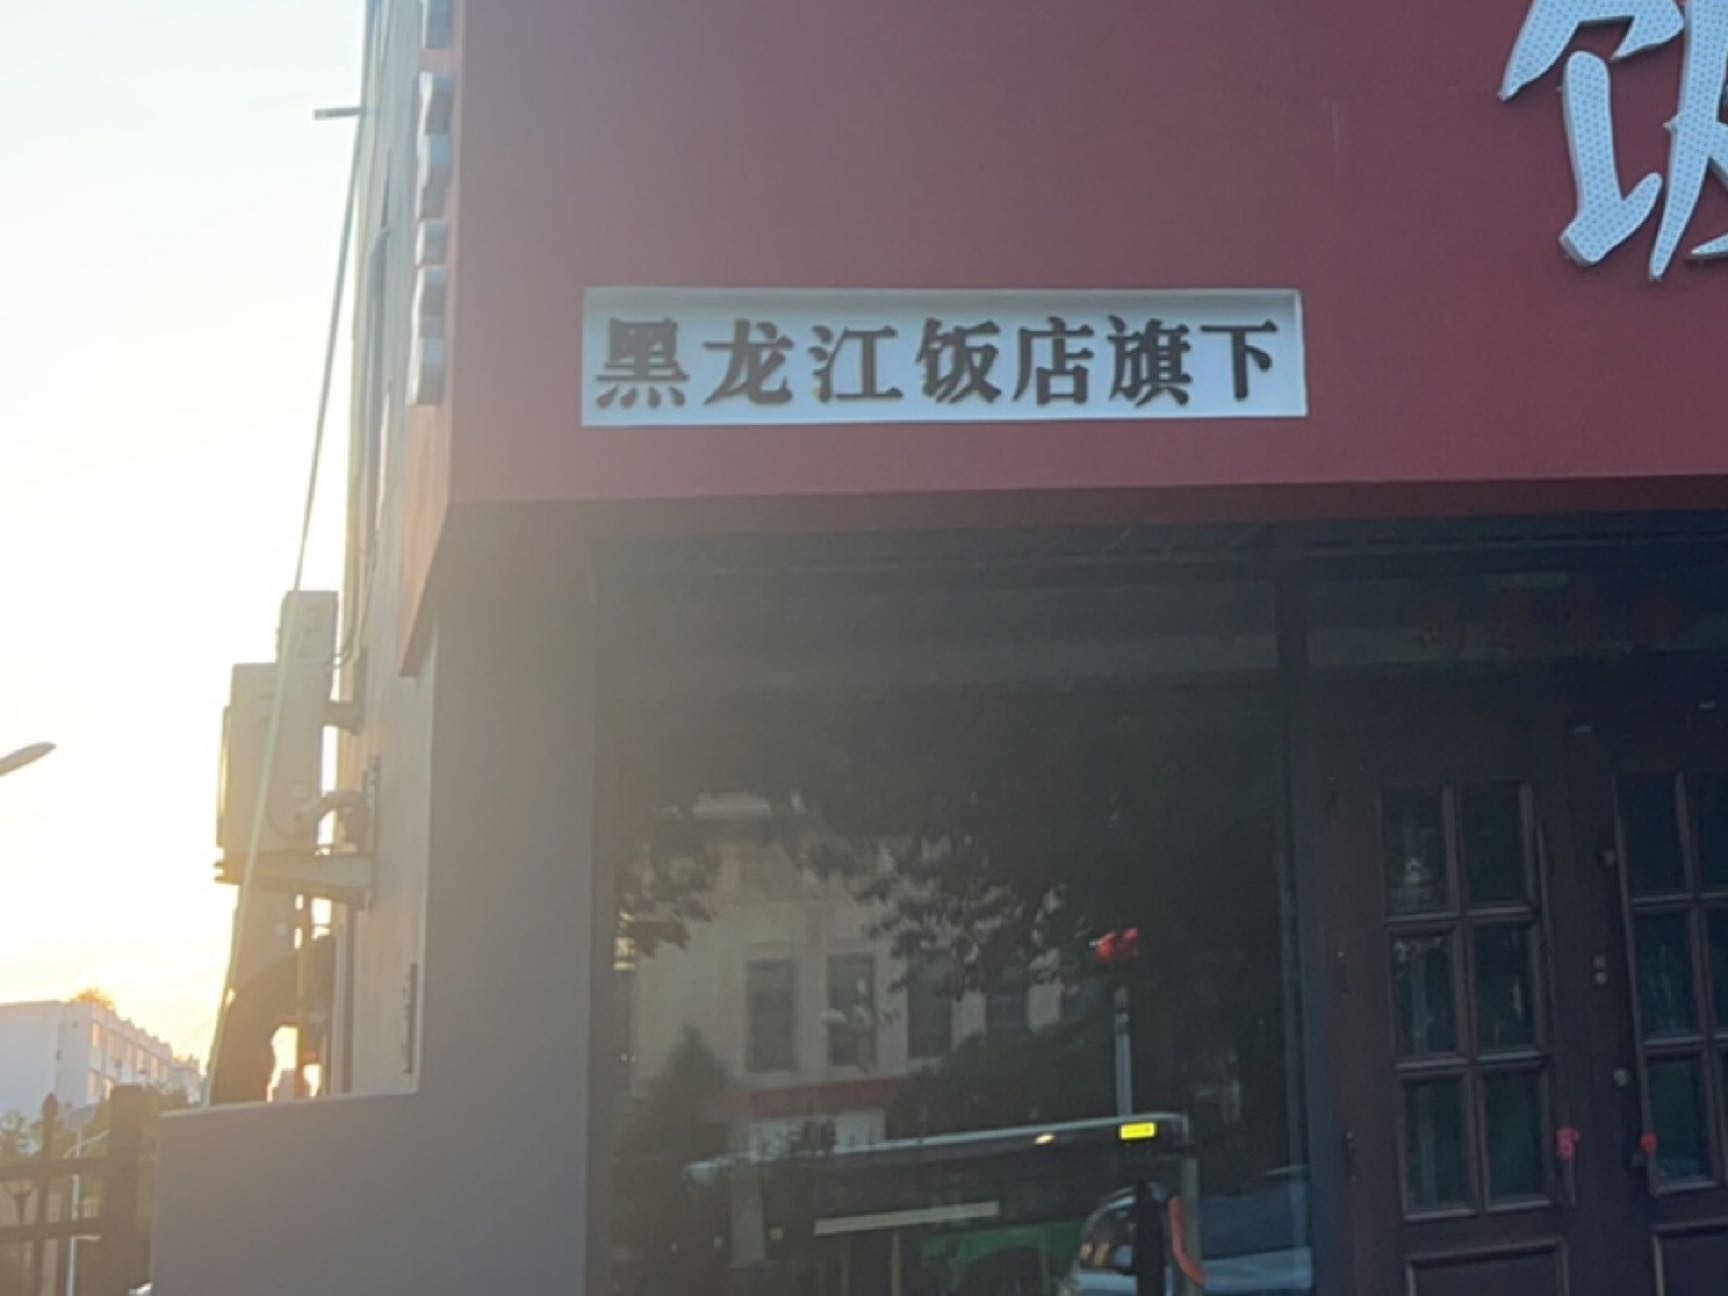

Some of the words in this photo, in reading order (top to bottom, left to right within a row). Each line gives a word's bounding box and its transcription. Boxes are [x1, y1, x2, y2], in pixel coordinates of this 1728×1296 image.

[594, 313, 1280, 410] 黑龙江饭店旗下
